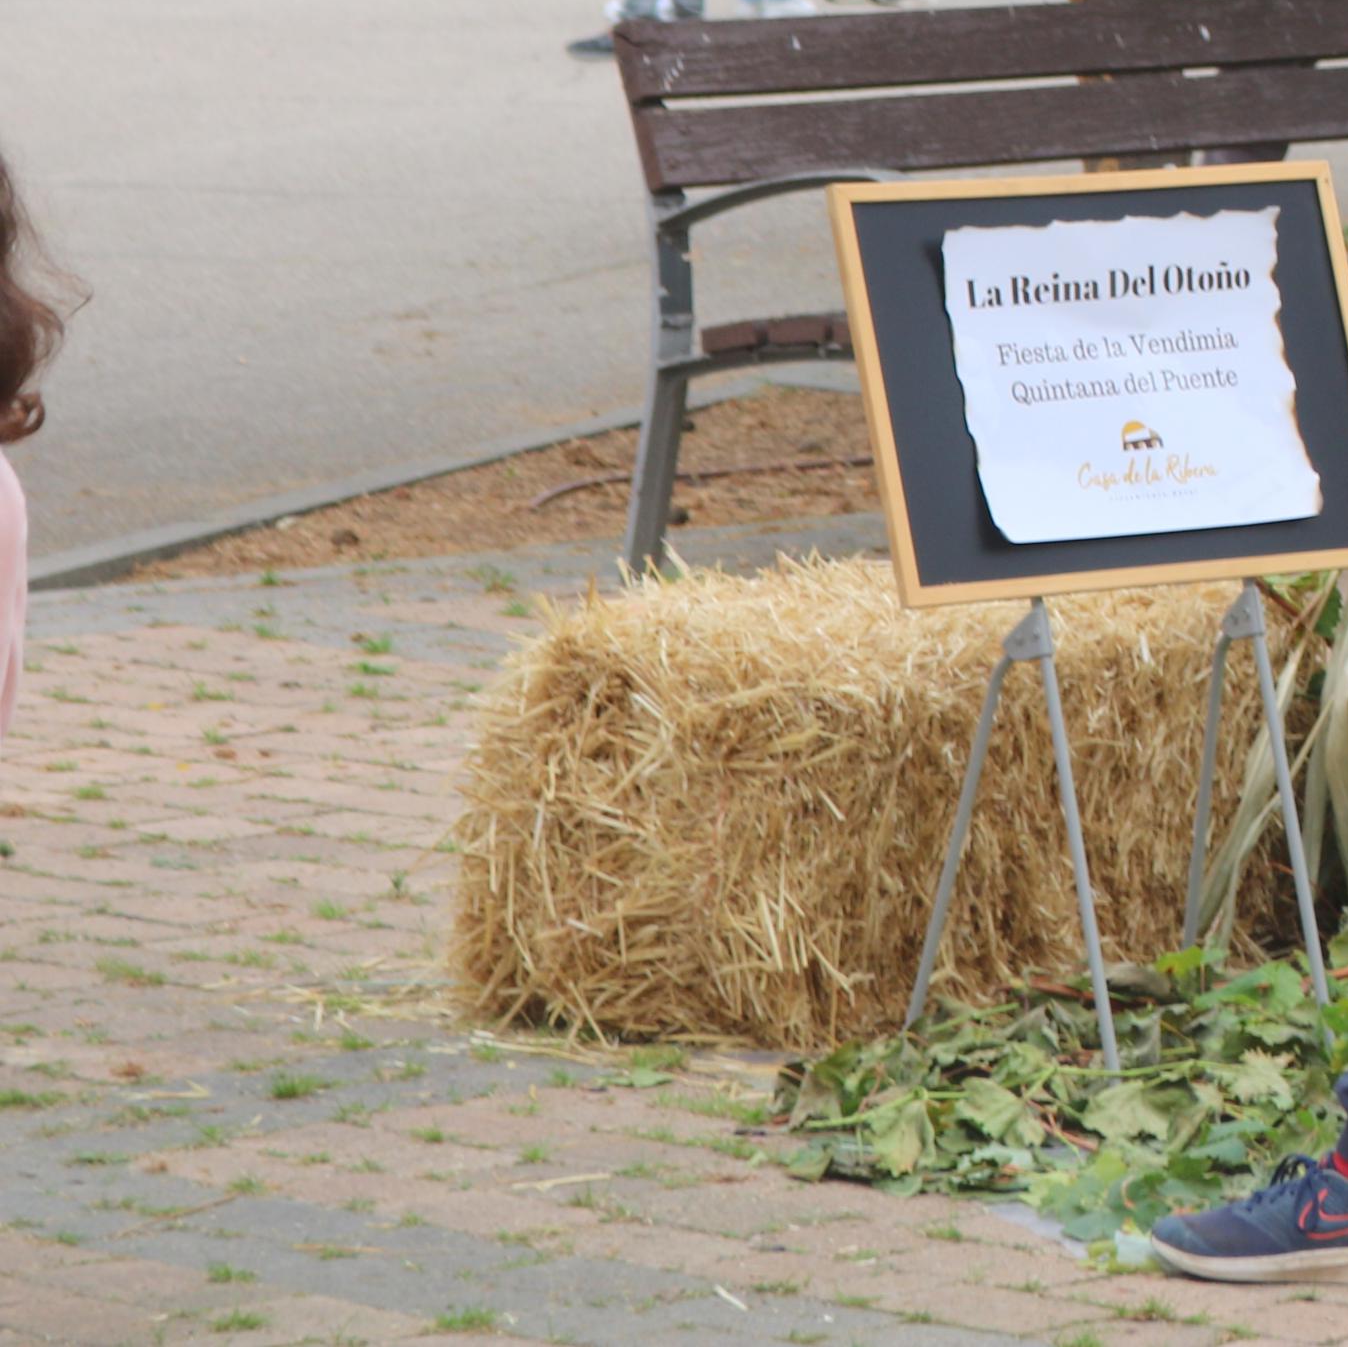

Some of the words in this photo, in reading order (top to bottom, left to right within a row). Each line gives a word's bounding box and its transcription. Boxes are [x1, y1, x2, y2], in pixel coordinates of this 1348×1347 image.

[966, 278, 1002, 309] La
[1010, 272, 1099, 306] Reina
[1108, 264, 1156, 299] Del
[1163, 261, 1251, 295] Otoño
[996, 341, 1068, 367] Fiesta
[1072, 337, 1099, 361] de
[1102, 336, 1127, 359] la
[1128, 327, 1239, 356] Vendimia
[1011, 377, 1120, 405] Quintana
[1124, 371, 1158, 396] del
[1160, 366, 1239, 392] Puente
[1077, 461, 1118, 491] Casa
[1122, 456, 1142, 485] de
[1145, 455, 1163, 485] la
[1166, 451, 1218, 485] Ribera
